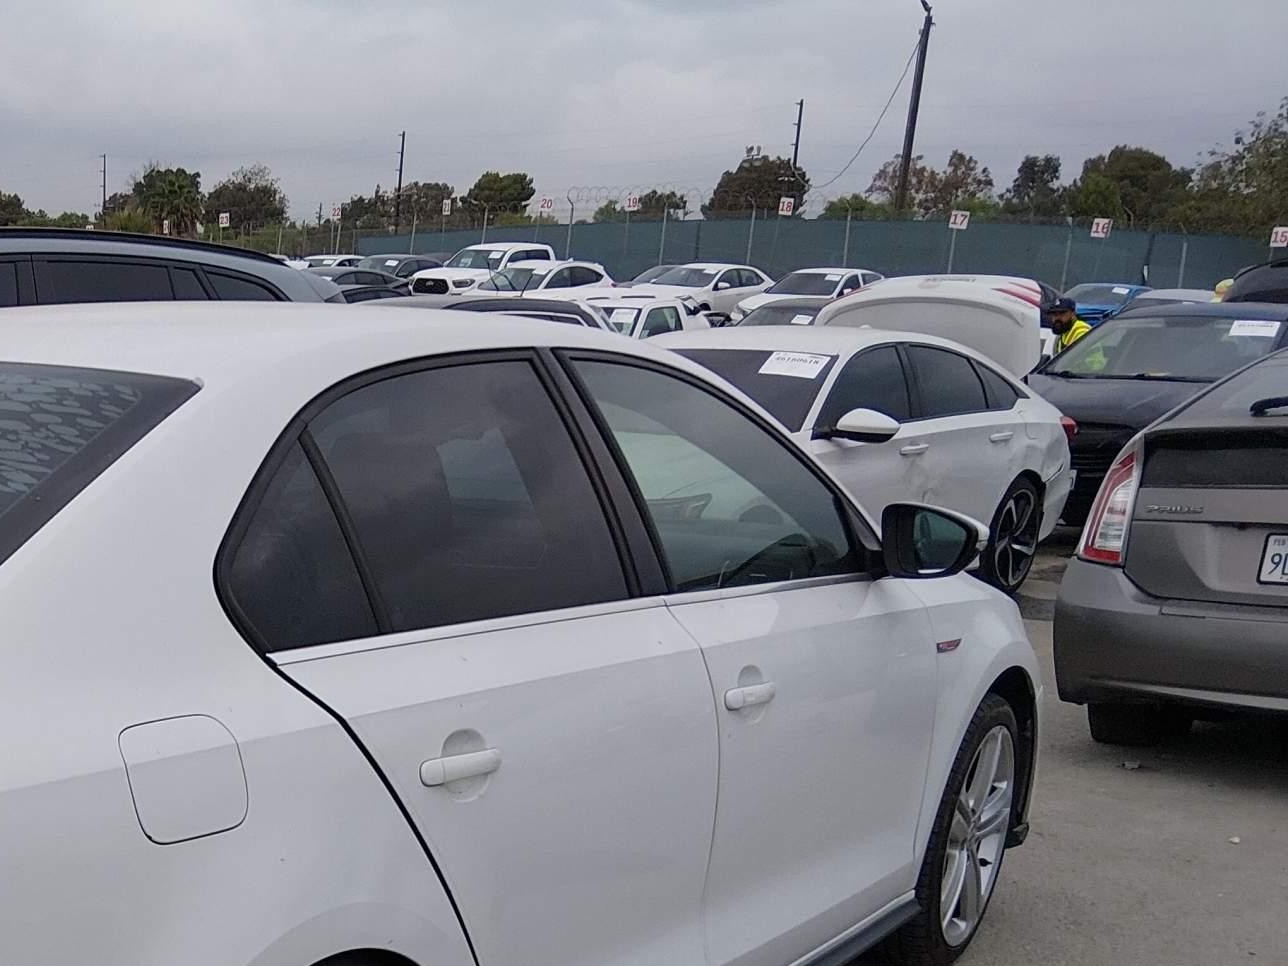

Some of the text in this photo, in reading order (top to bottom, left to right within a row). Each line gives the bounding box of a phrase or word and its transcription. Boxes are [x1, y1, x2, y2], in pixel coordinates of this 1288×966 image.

[540, 198, 552, 209] 20
[626, 197, 638, 208] 19
[779, 200, 792, 213] 18
[332, 207, 341, 217] 22
[219, 215, 229, 225] 23
[950, 213, 969, 226] 17
[1093, 222, 1110, 234] 16
[1271, 230, 1288, 243] 15
